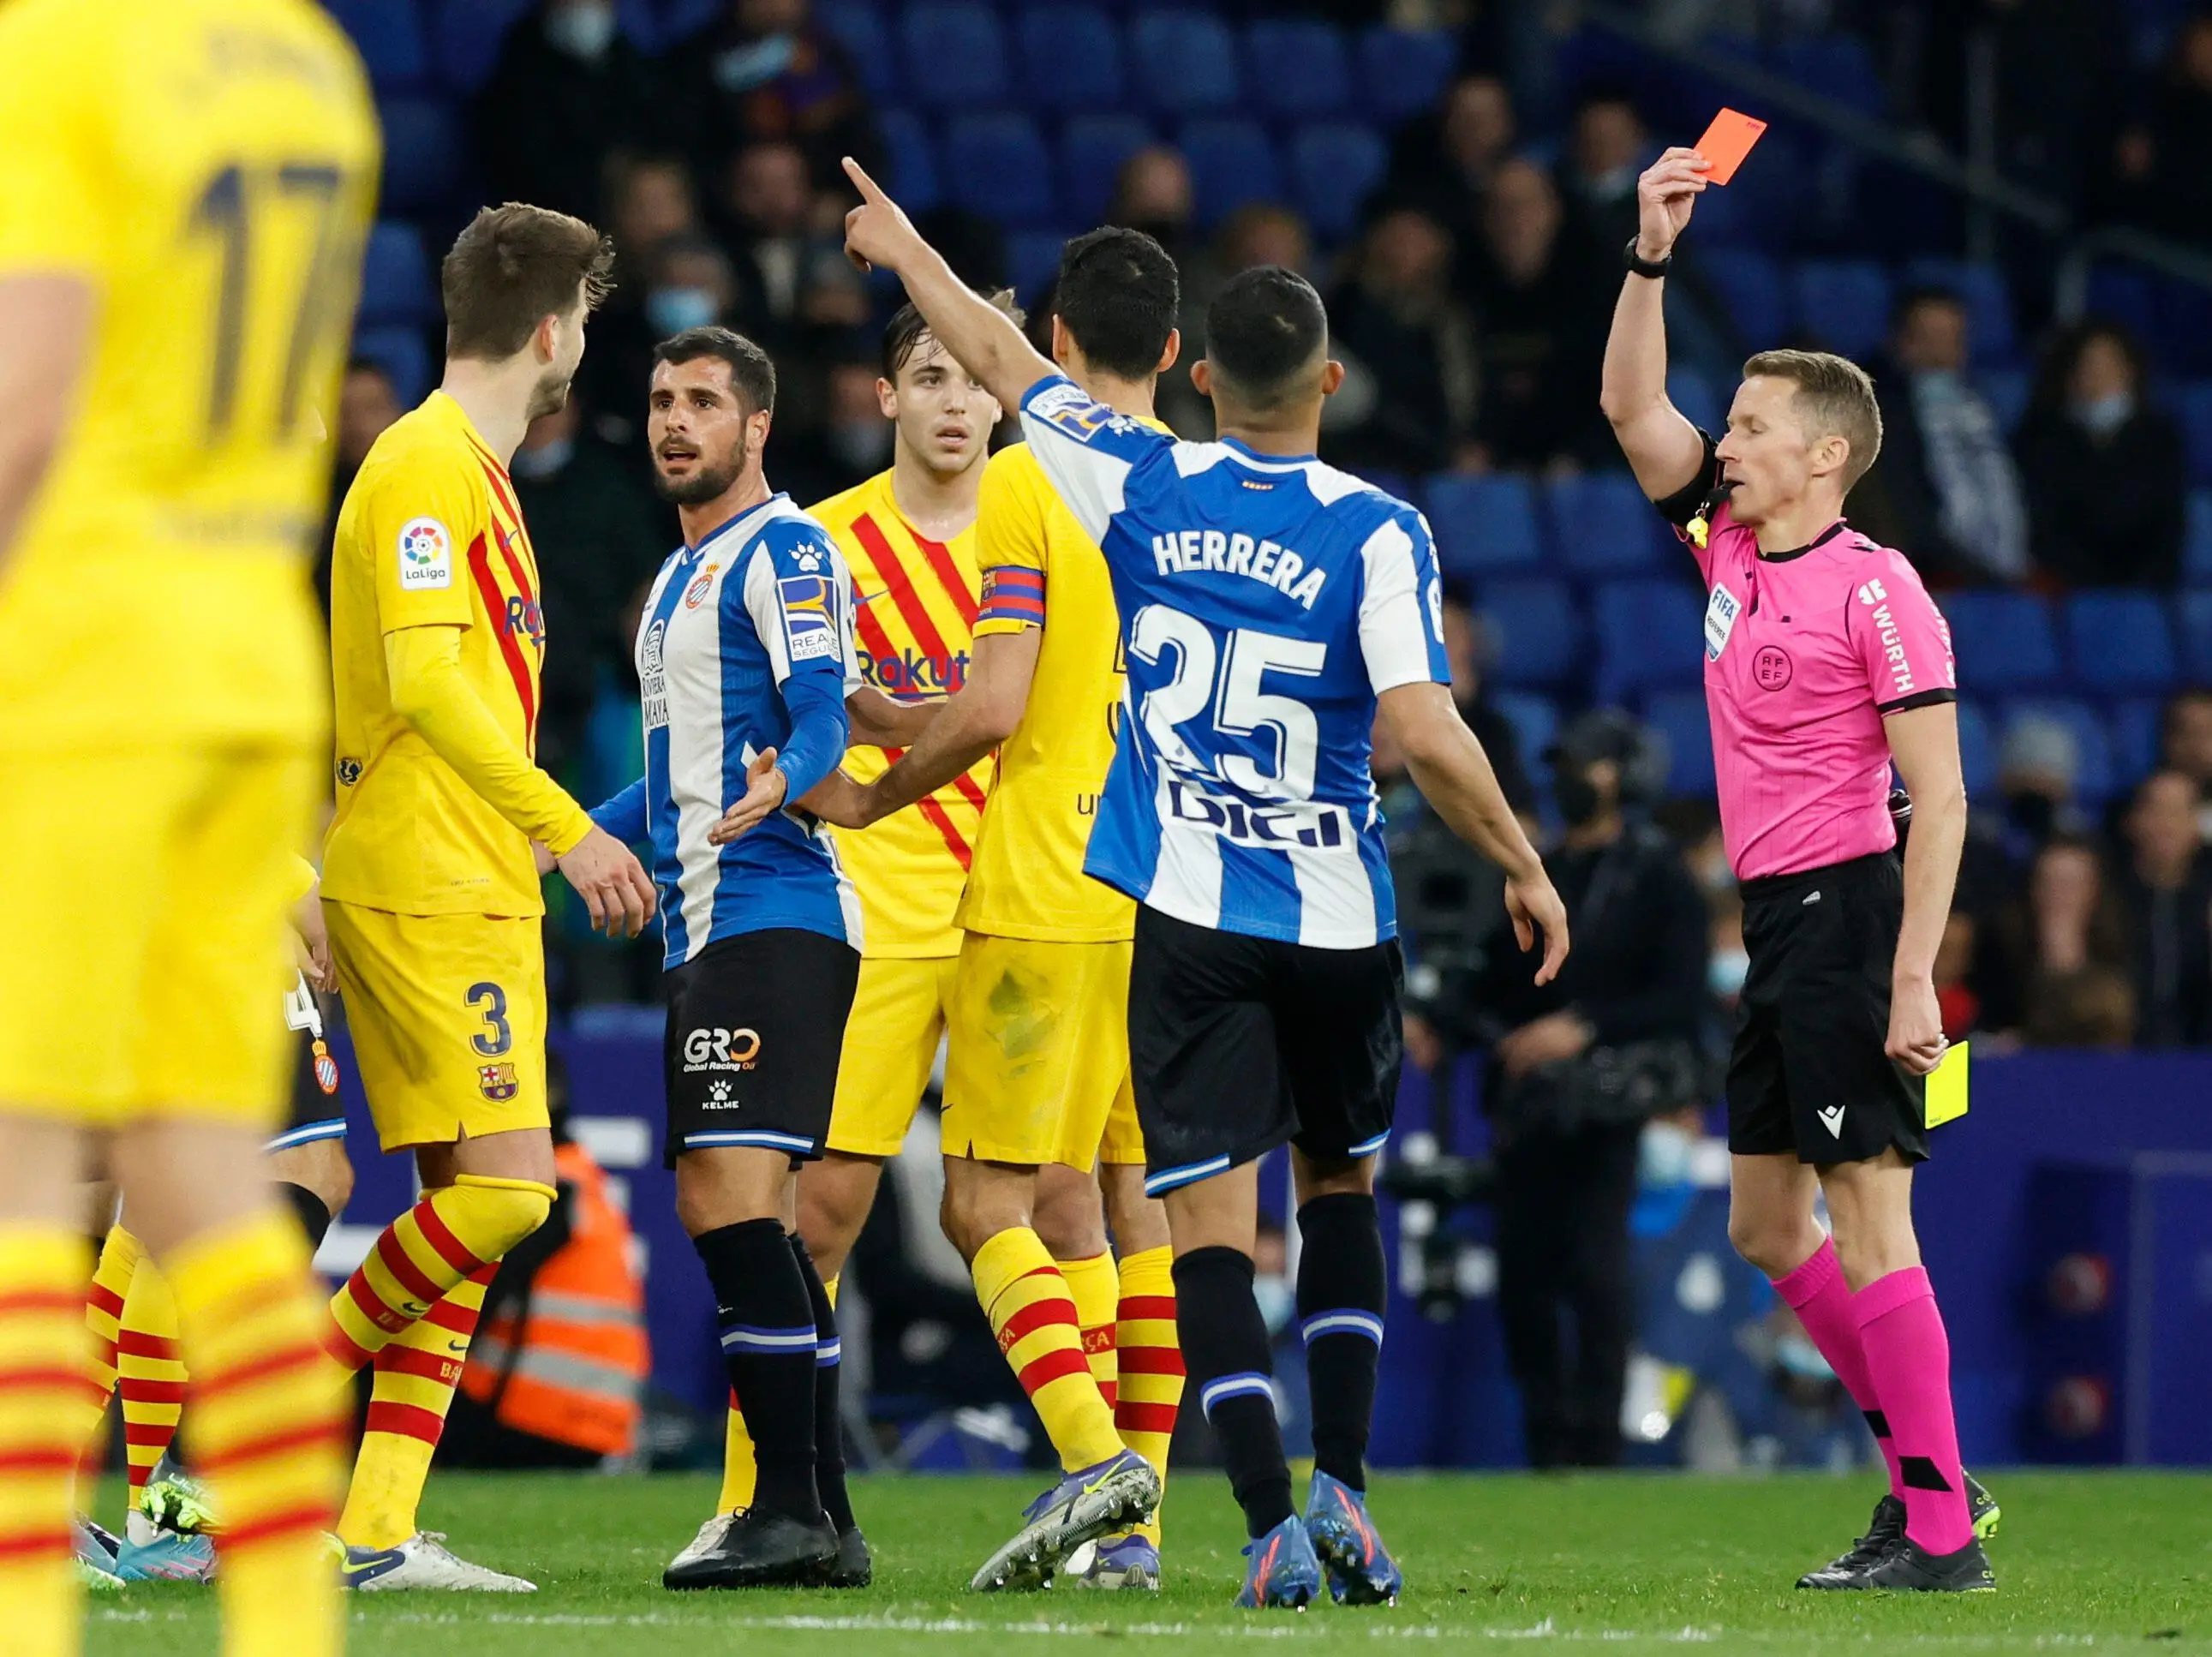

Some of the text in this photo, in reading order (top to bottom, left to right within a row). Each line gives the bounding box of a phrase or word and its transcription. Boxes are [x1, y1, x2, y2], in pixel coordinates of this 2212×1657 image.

[188, 163, 356, 435] 17
[406, 568, 445, 580] LaLiga
[1151, 529, 1327, 611] HERRERA
[1713, 589, 1736, 621] FIFA
[1872, 604, 1915, 692] WÜRTH
[644, 698, 670, 727] MAYA
[1128, 602, 1327, 802] 25
[463, 982, 512, 1057] 3
[684, 1028, 761, 1063] GRO
[684, 1063, 708, 1073] Global
[709, 1062, 741, 1072] Racing
[702, 1101, 739, 1110] KELME
